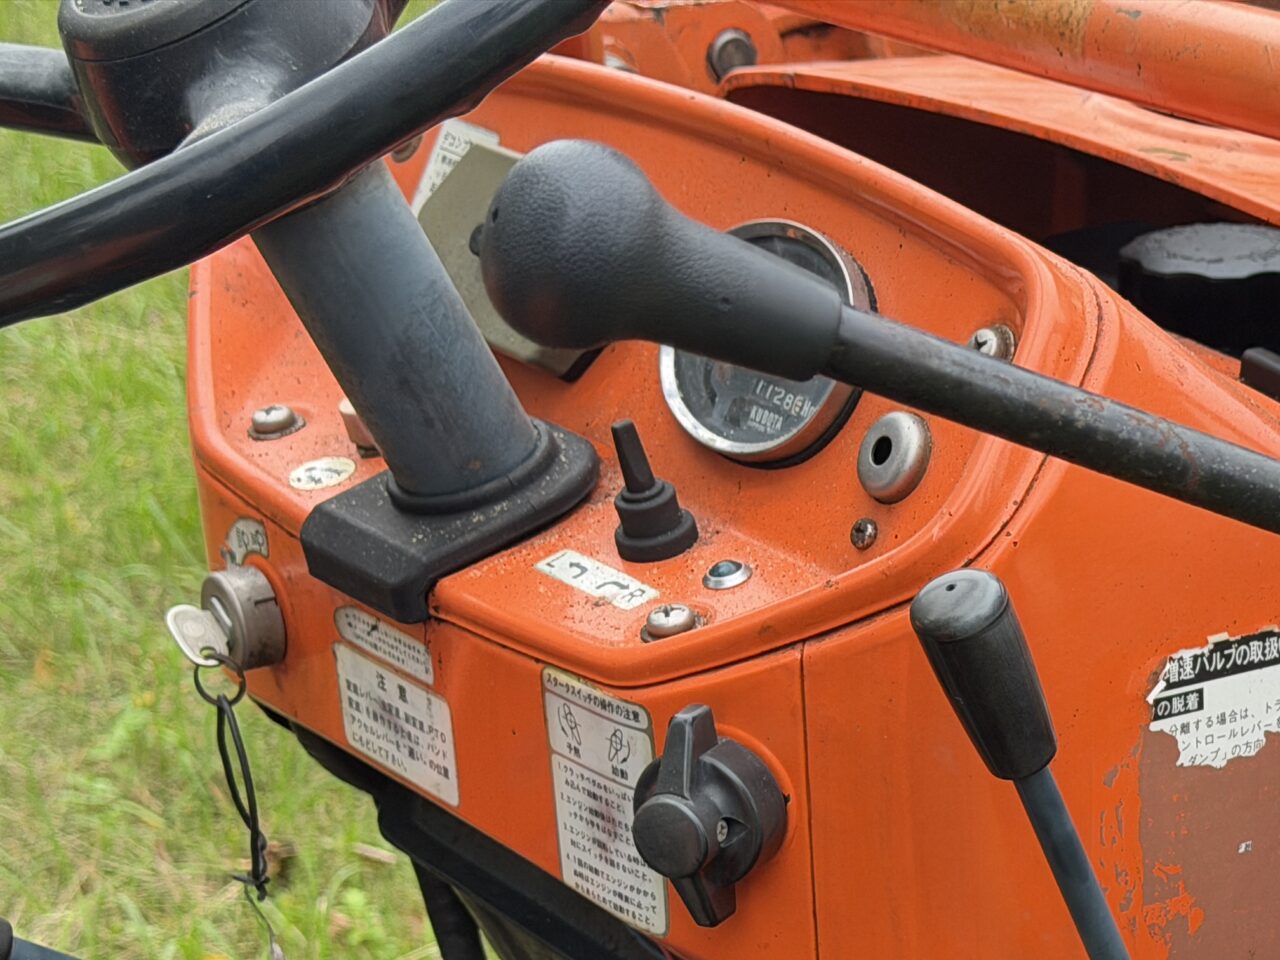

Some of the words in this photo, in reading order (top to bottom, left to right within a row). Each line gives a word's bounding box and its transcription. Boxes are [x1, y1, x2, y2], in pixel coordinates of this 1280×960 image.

[751, 404, 784, 431] KUBOTA
[1153, 692, 1200, 719] の脱着
